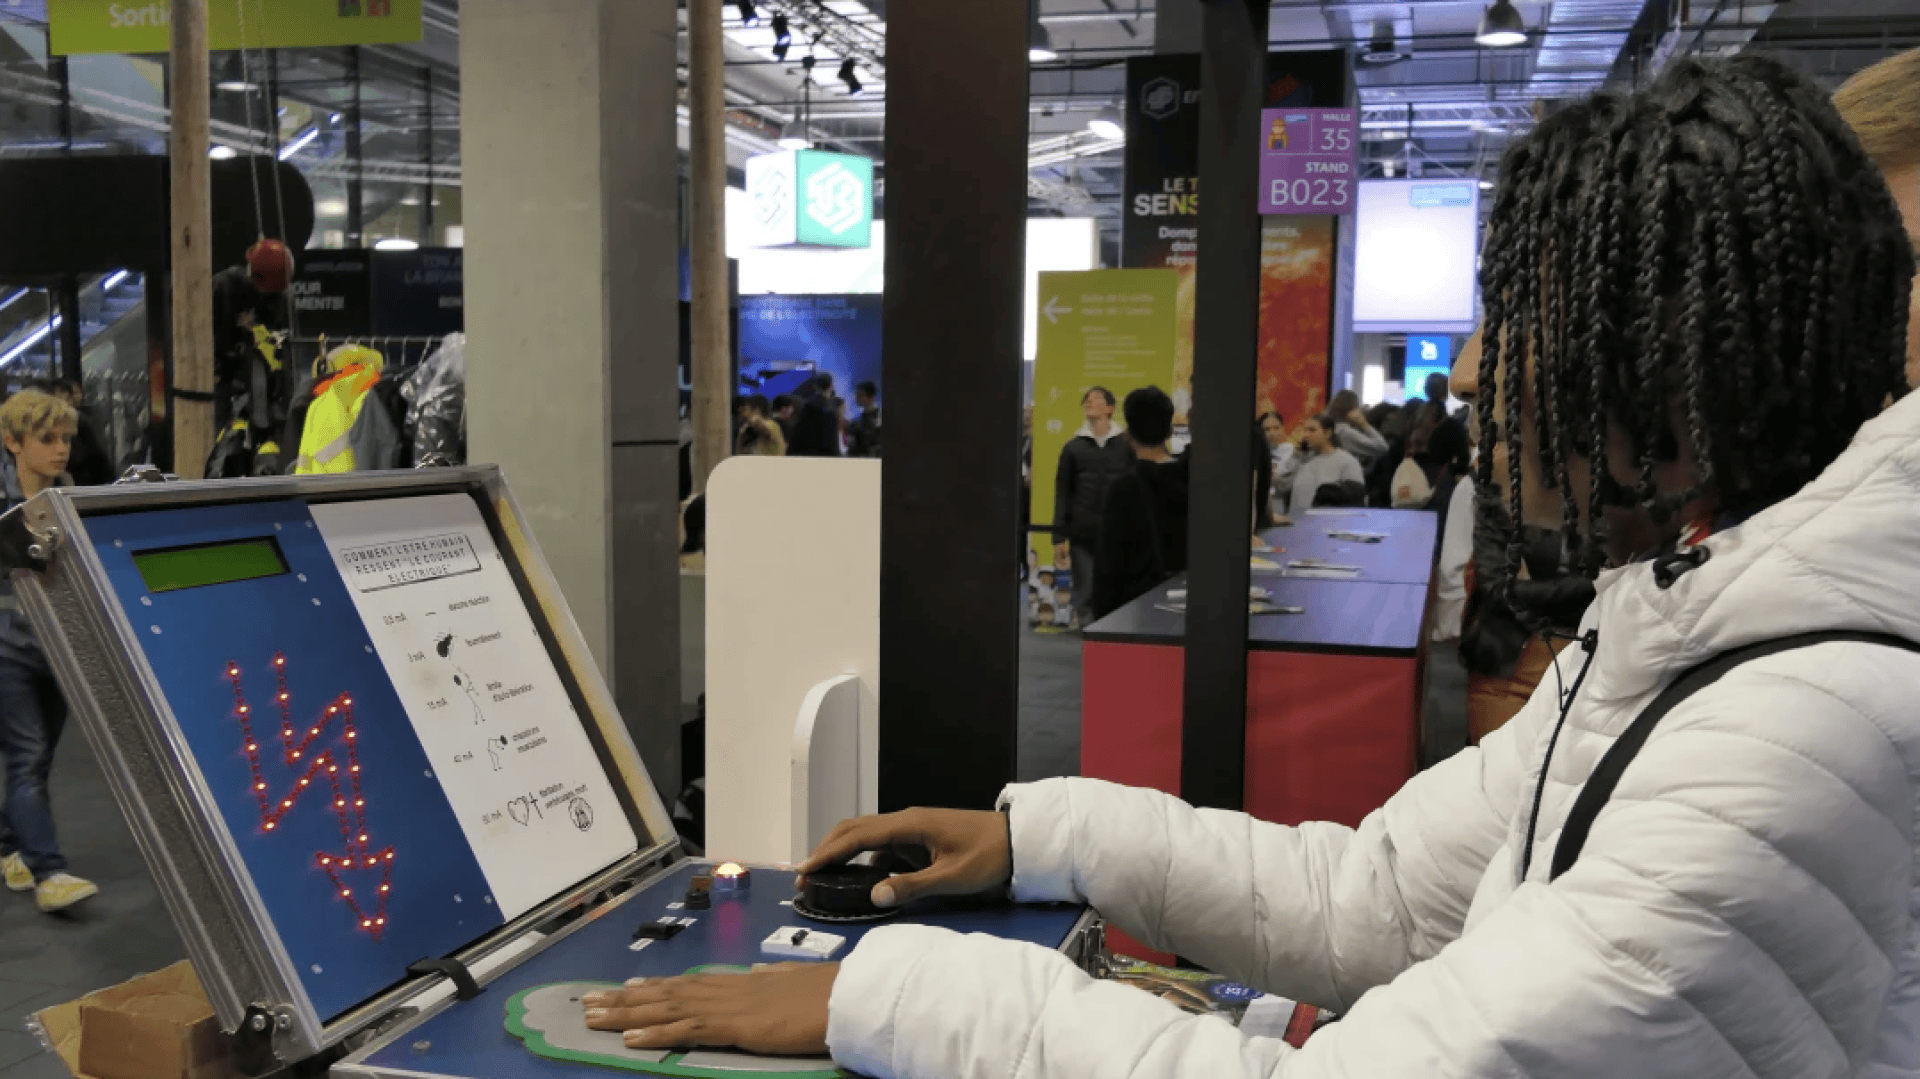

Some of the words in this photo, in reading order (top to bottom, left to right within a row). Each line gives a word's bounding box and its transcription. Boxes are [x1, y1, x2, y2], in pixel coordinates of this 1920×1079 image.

[1322, 113, 1351, 121] HALLE
[1320, 127, 1351, 150] 35
[1305, 161, 1349, 174] STAND
[1163, 177, 1185, 192] LE
[1270, 178, 1348, 206] B023
[344, 546, 392, 563] COMMENT
[430, 535, 464, 550] HUMAIN
[355, 558, 401, 574] RESSENT
[423, 547, 465, 564] COURANT
